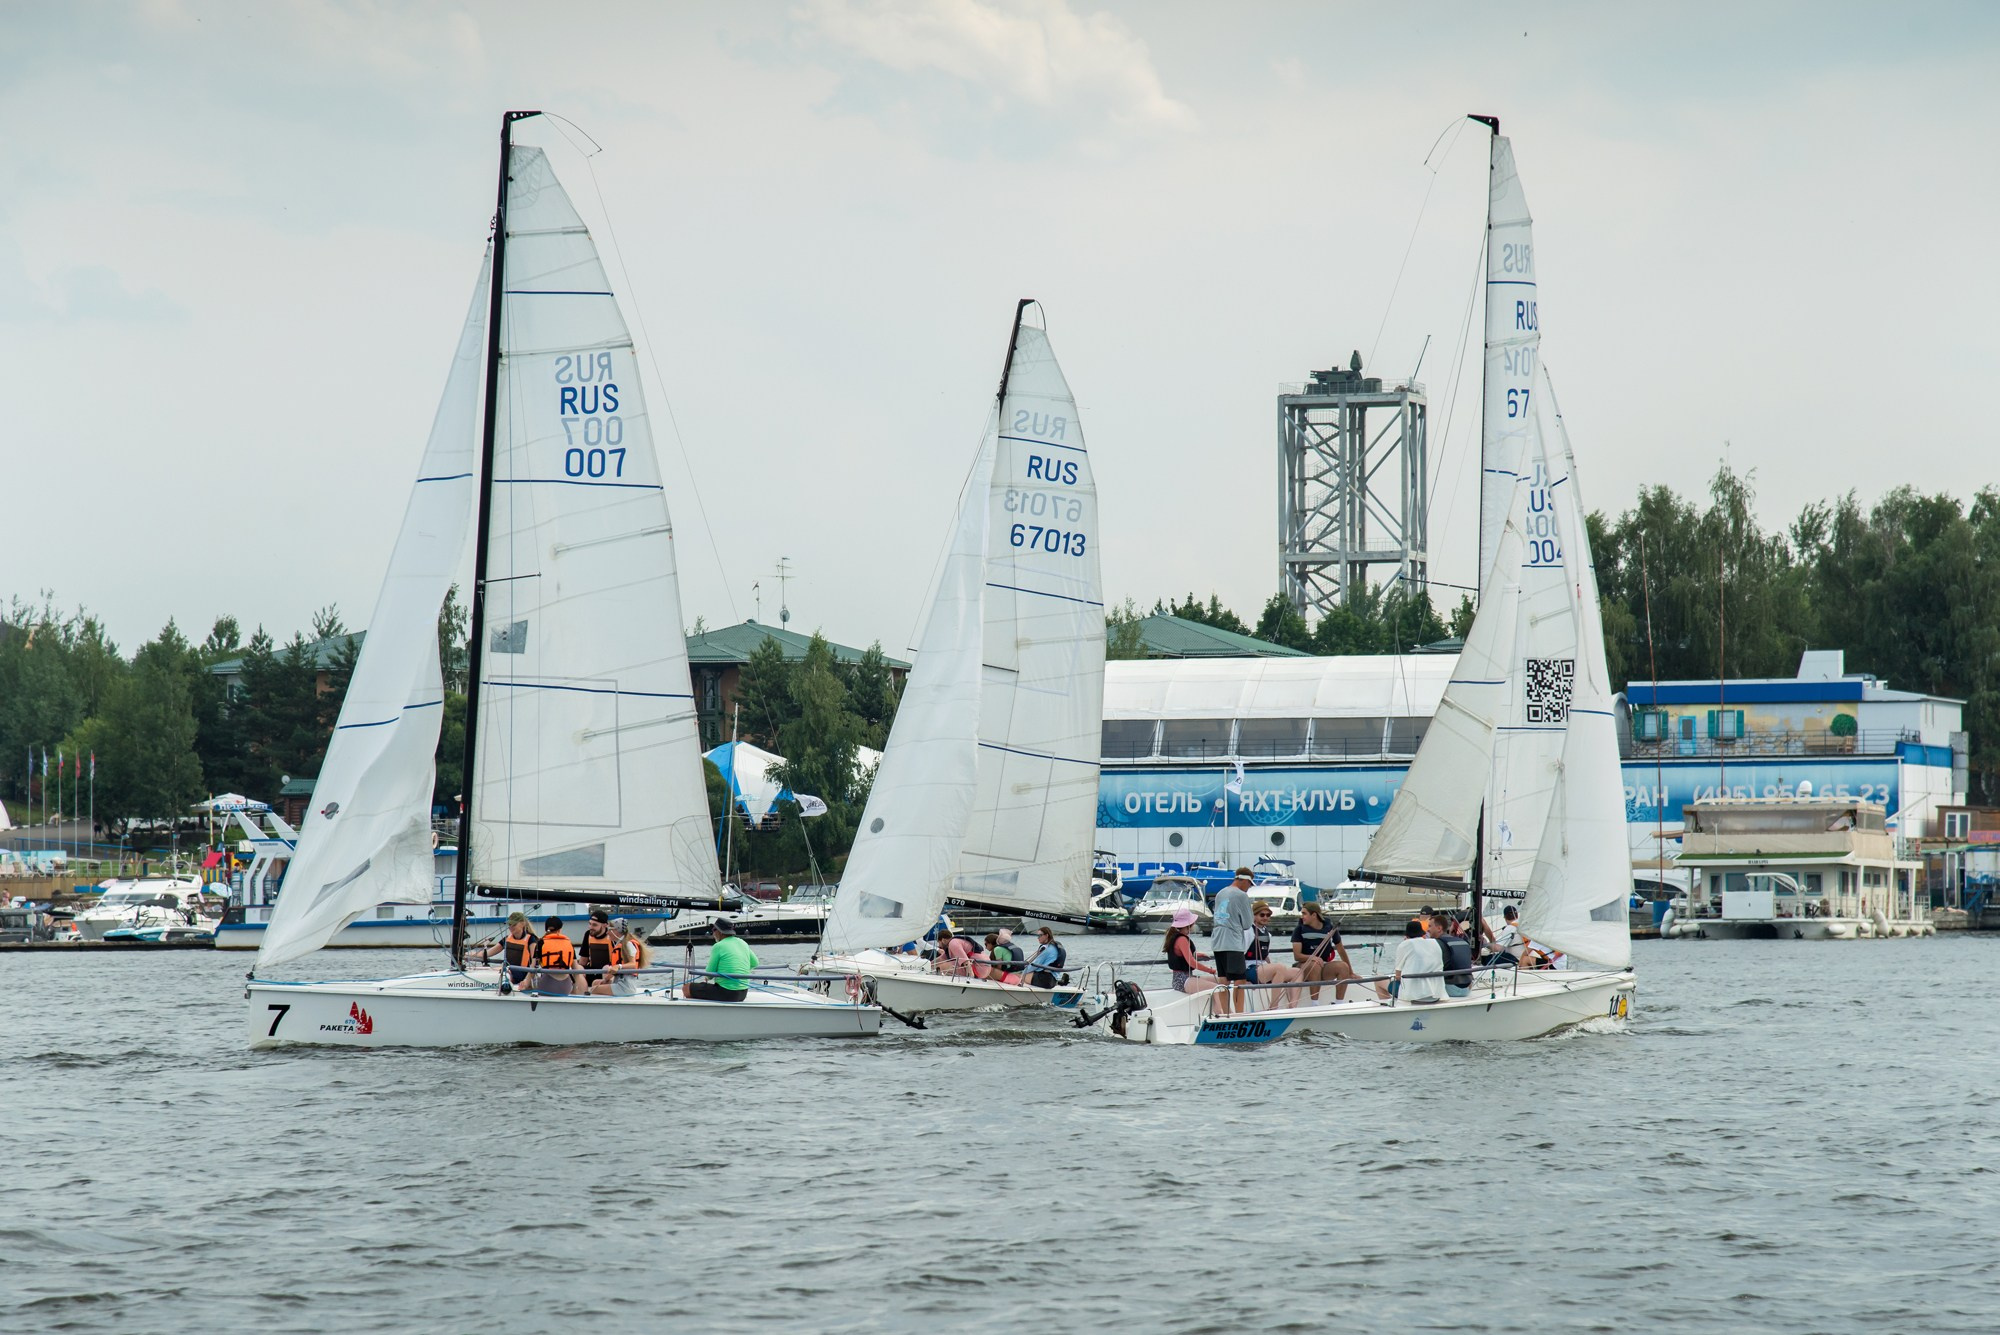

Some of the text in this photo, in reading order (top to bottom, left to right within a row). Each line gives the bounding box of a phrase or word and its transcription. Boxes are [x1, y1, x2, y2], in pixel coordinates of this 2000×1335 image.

[1516, 300, 1538, 331] RUS
[560, 383, 619, 415] RUS
[1507, 388, 1531, 418] 67
[565, 447, 627, 478] 007
[1027, 455, 1079, 485] RUS
[1010, 523, 1087, 557] 67013
[1124, 792, 1202, 814] ОТЕЛЬ
[1238, 789, 1356, 812] ЯХТ-КЛУБ
[1860, 783, 1890, 806] 23
[619, 895, 679, 907] windsailing.ru
[951, 898, 966, 906] 670
[1025, 910, 1058, 921] MoreSail.ru
[267, 1004, 291, 1037] 7
[1216, 1031, 1238, 1039] RUS
[1236, 1021, 1266, 1038] 670
